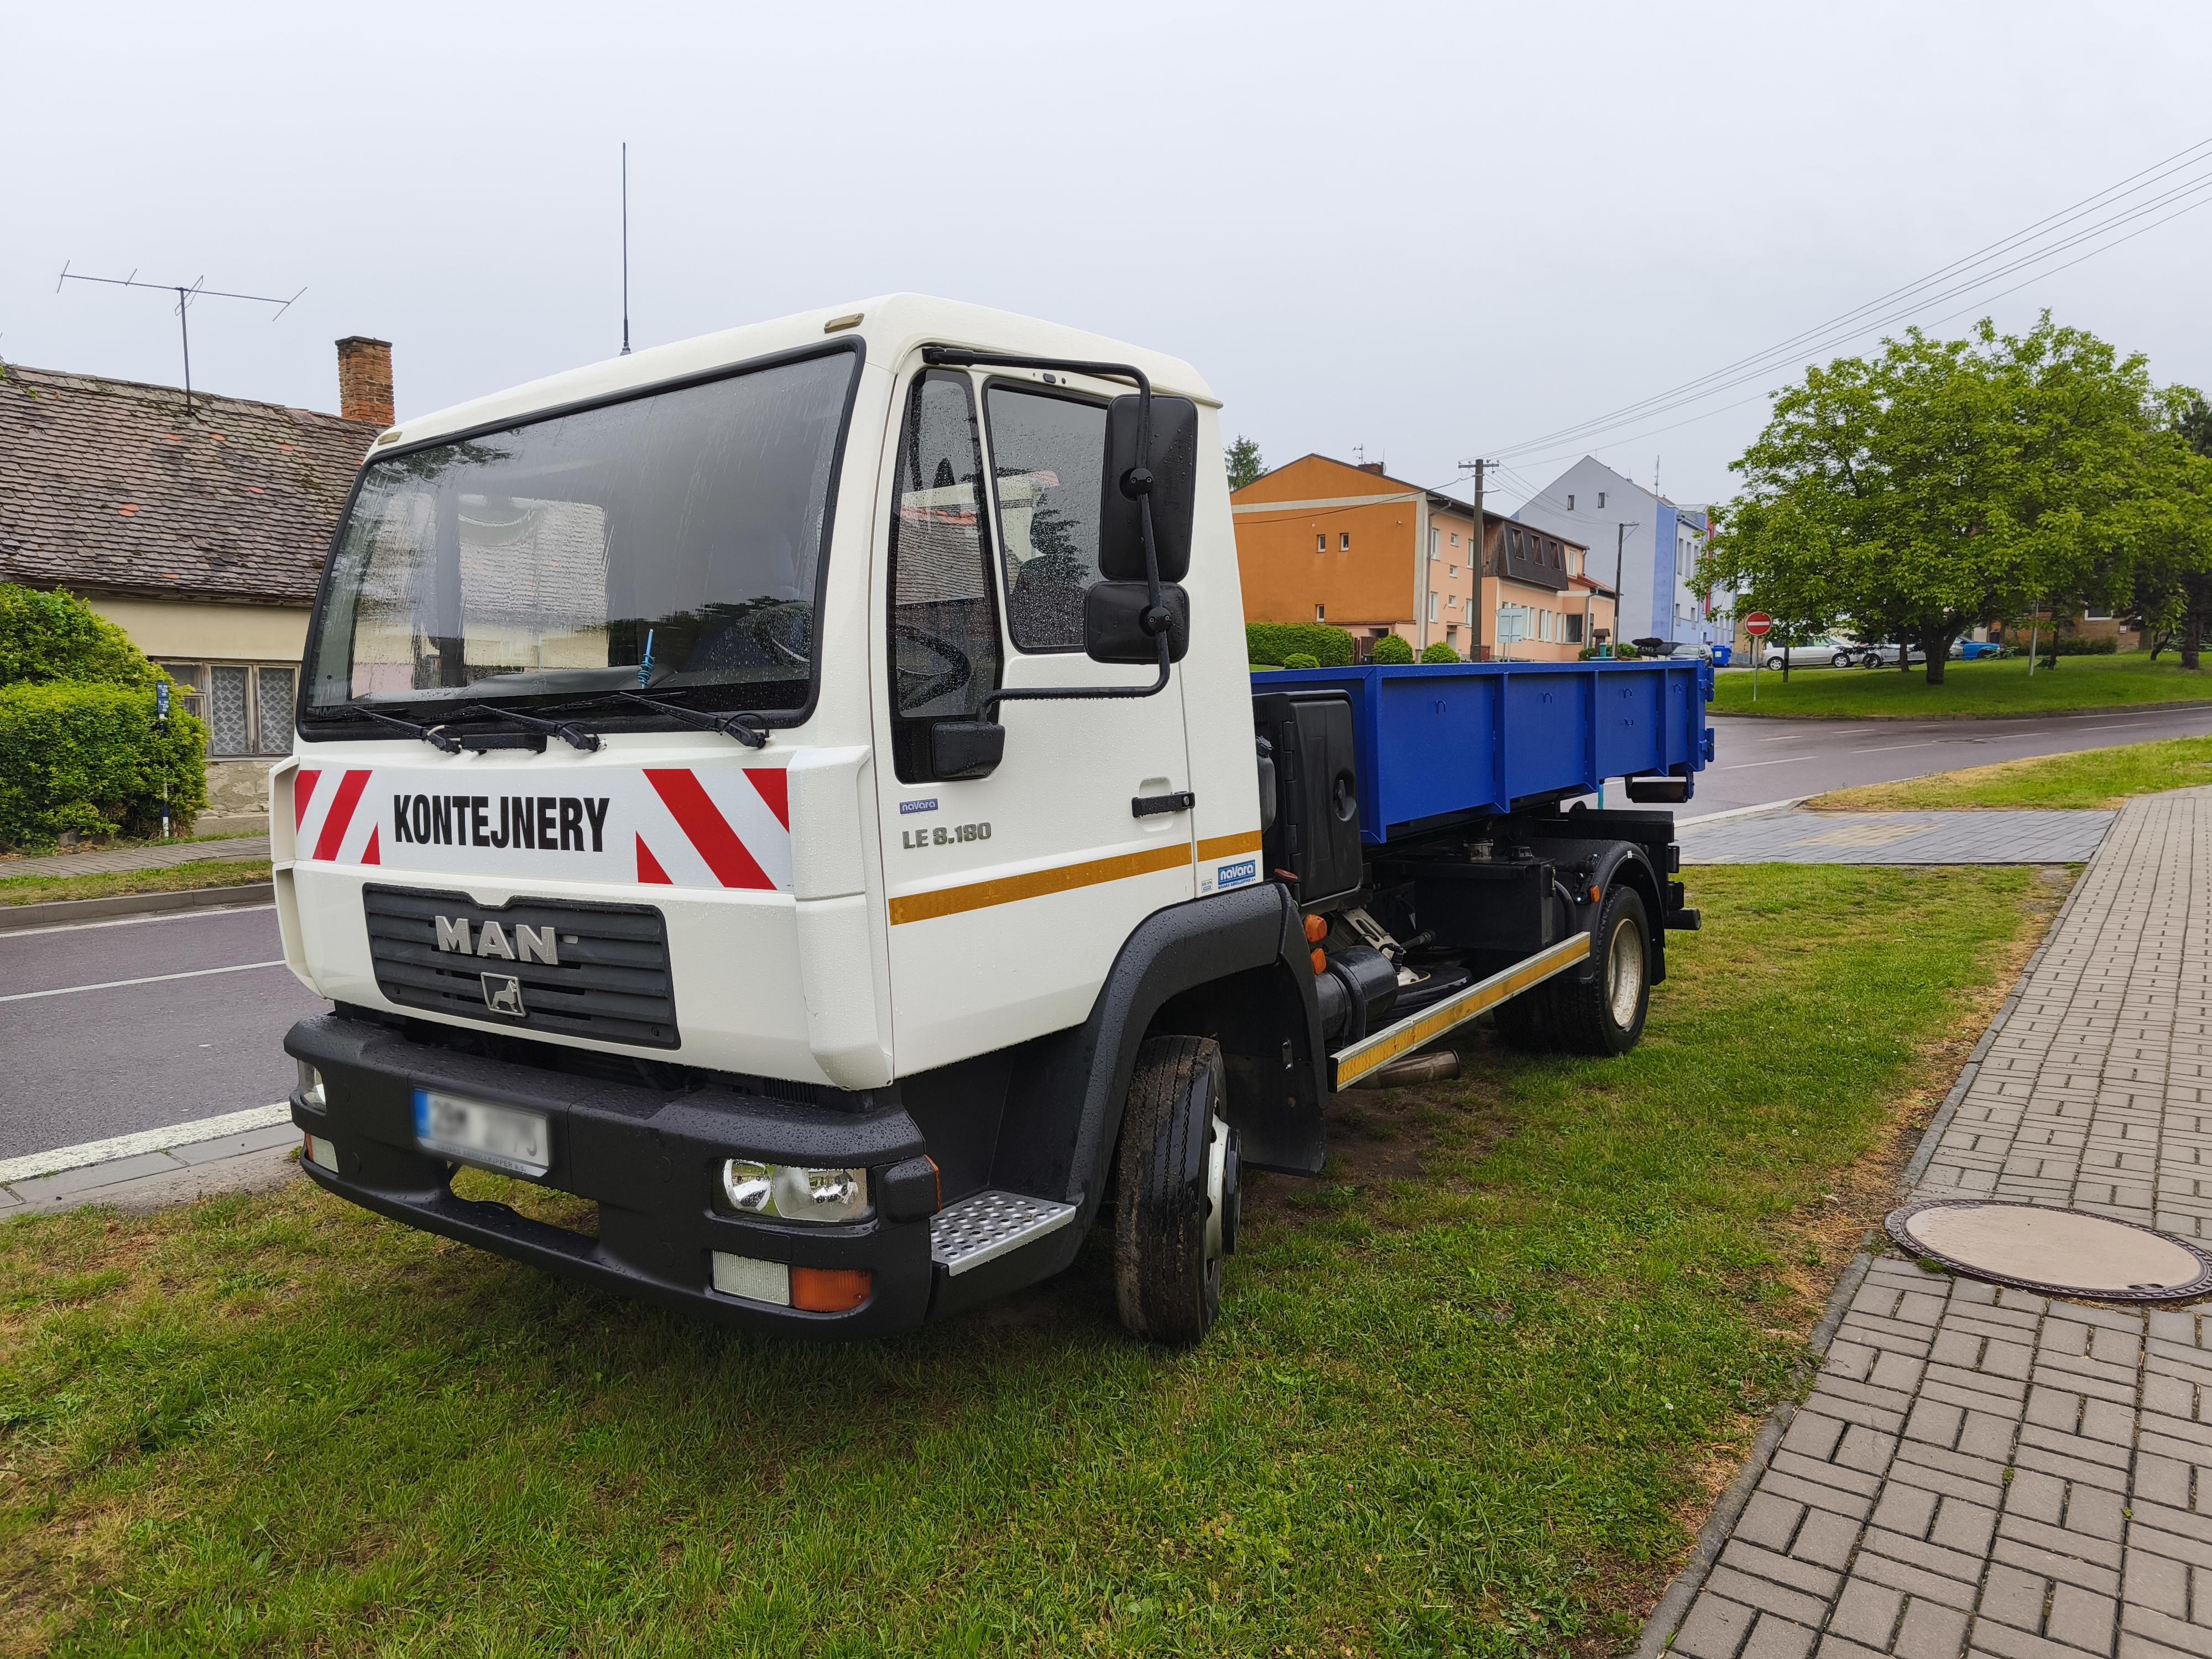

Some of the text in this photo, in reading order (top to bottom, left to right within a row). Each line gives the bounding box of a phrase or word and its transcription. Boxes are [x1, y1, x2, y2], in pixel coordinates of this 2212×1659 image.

[393, 794, 609, 852] KONTEJNERY
[902, 822, 992, 849] LE 8.180
[435, 915, 559, 965] MAN
[436, 1143, 526, 1173] NAVARA ABROLLKIPPER a.s.
